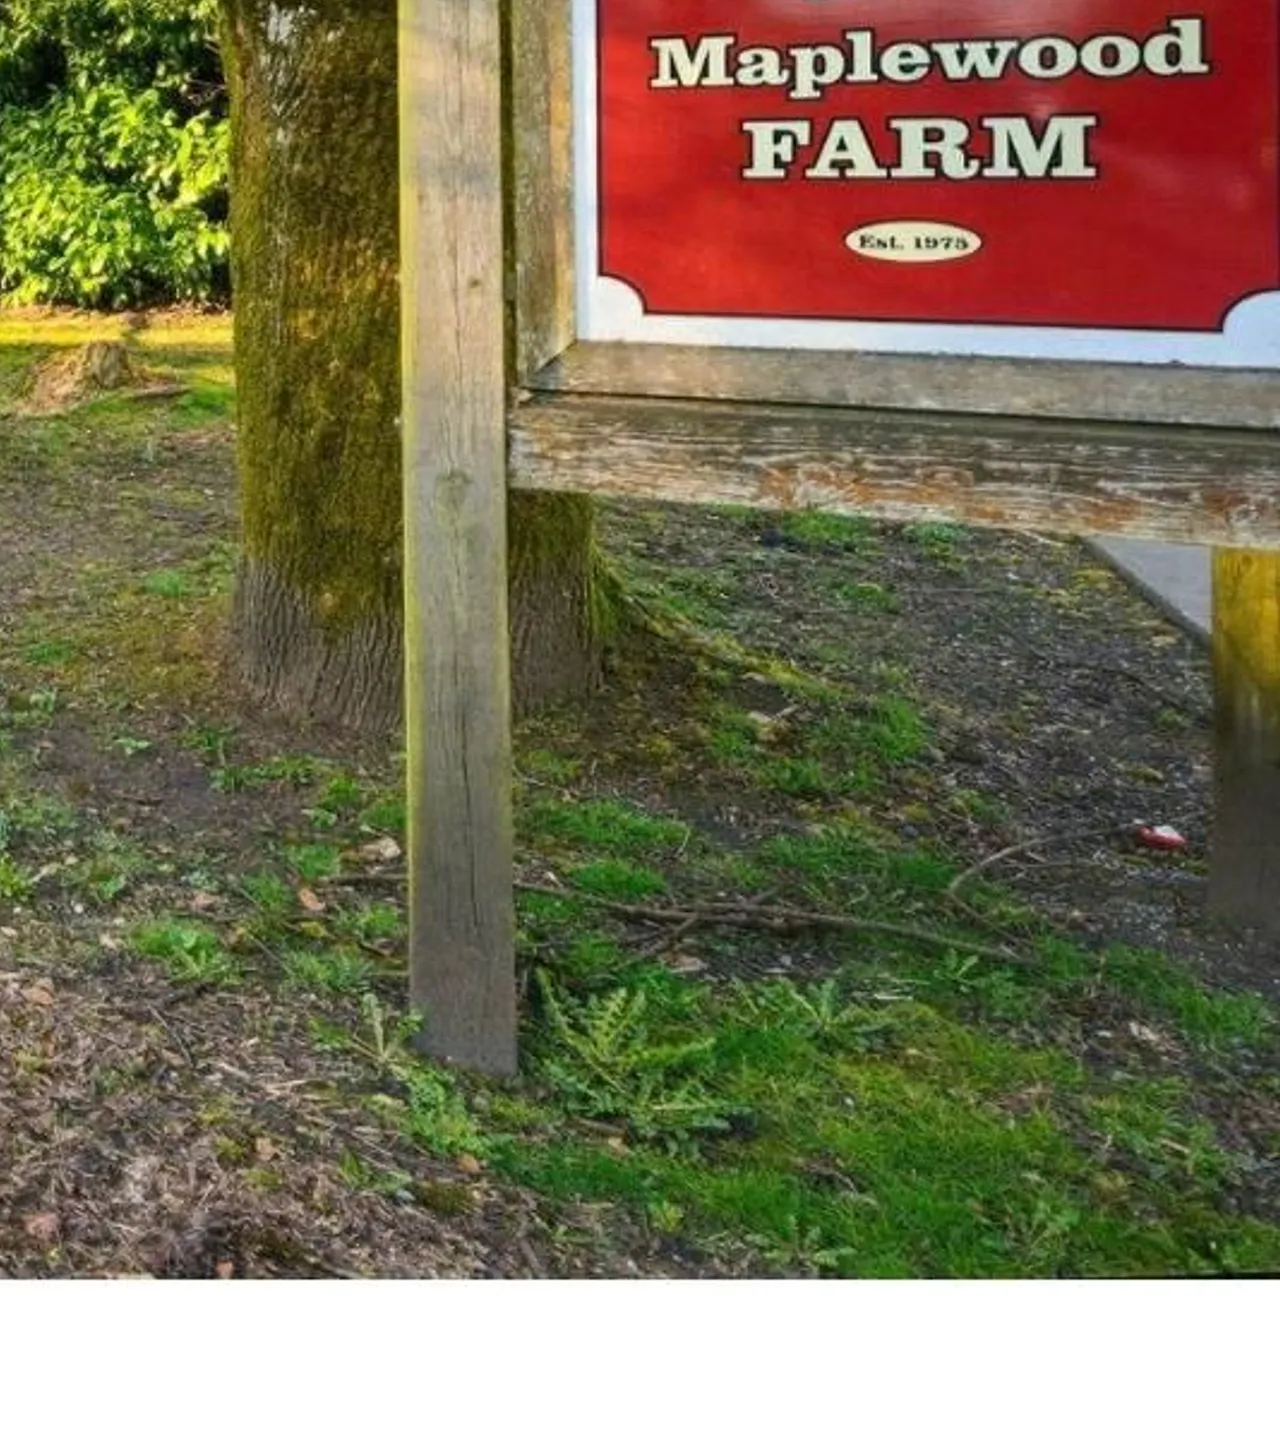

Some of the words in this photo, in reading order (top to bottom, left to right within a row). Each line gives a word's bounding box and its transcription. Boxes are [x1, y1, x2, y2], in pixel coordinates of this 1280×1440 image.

[650, 18, 1209, 100] Maplewood
[741, 115, 1098, 181] FARM
[859, 234, 905, 250] Est.
[914, 236, 969, 251] 1975
